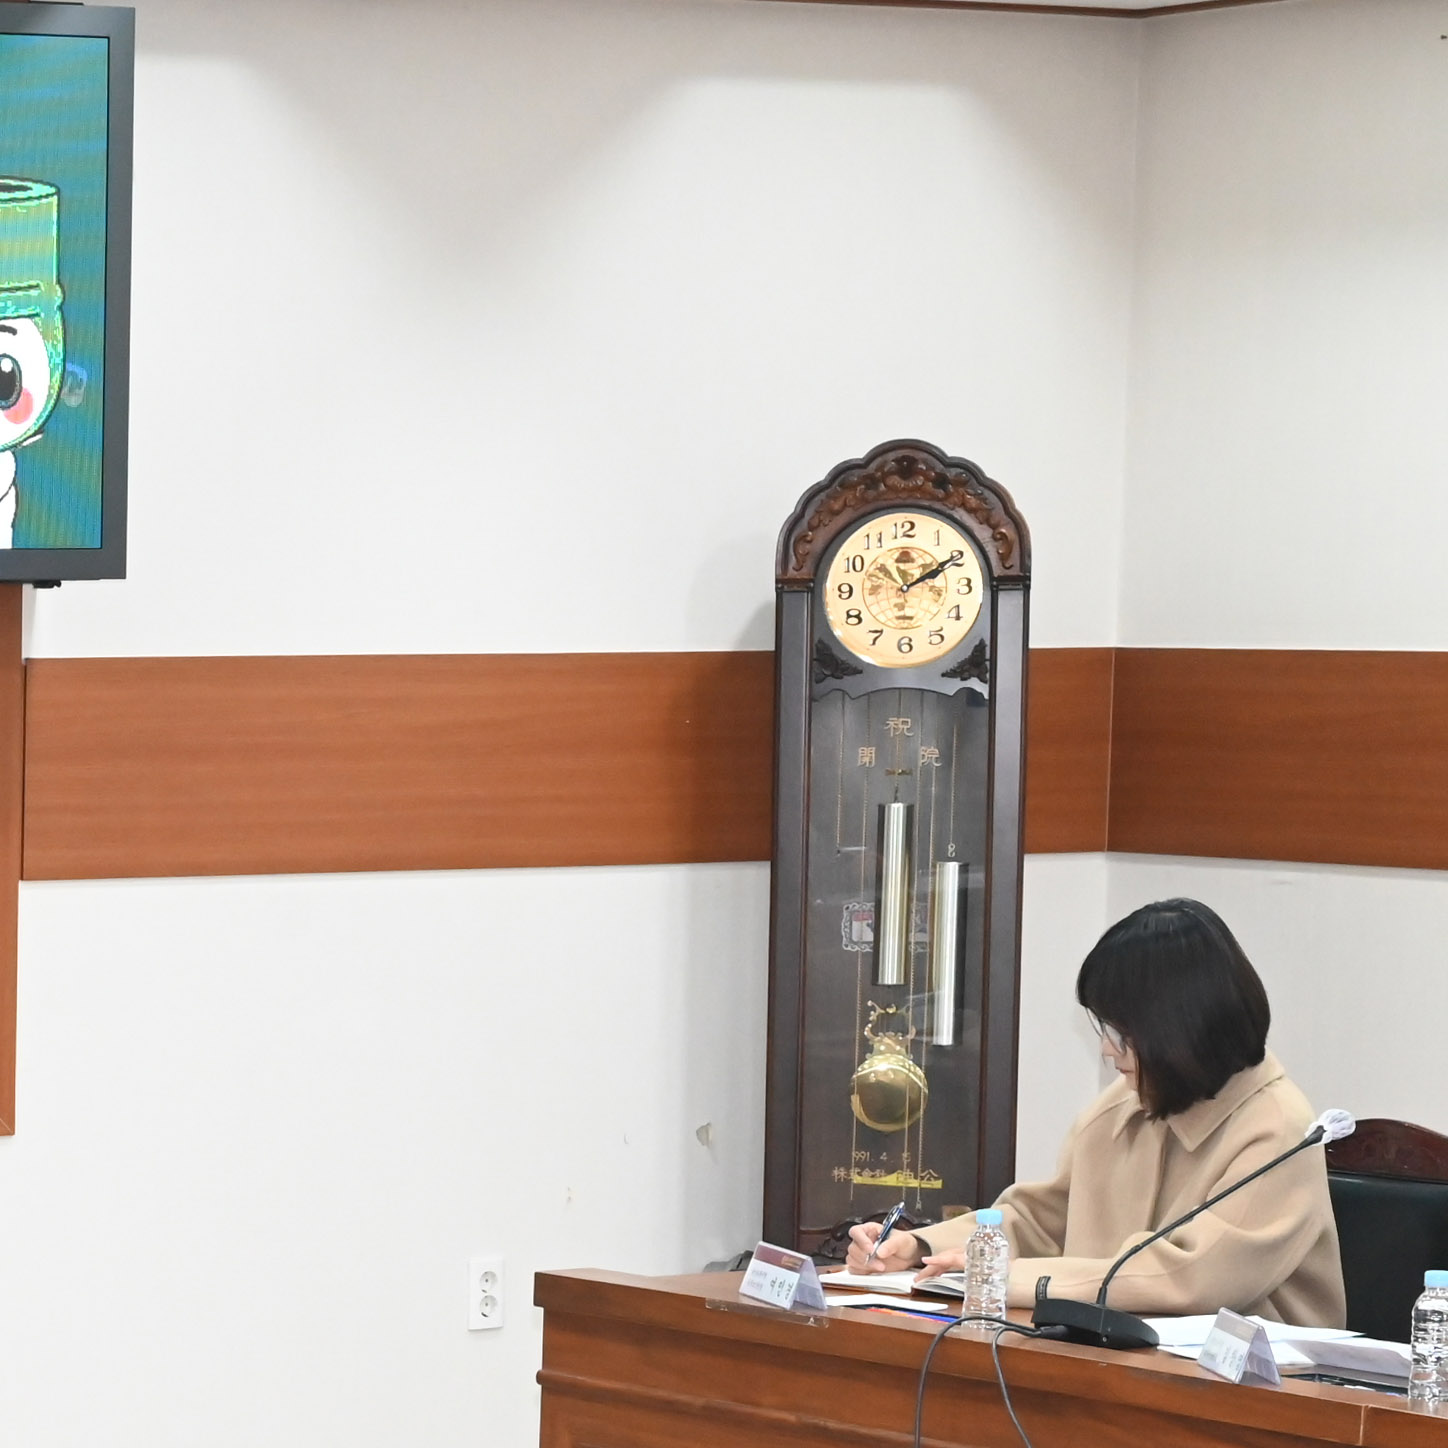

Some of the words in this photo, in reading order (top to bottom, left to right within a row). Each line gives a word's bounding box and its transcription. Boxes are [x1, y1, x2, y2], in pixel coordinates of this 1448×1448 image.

[891, 520, 916, 539] 12
[933, 529, 940, 546] 1
[864, 532, 883, 550] 11
[844, 554, 865, 573] 10
[949, 550, 965, 567] 2
[837, 582, 854, 600] 9
[956, 577, 973, 595] 3
[845, 608, 863, 626] 8
[947, 604, 963, 621] 4
[867, 628, 884, 646] 7
[928, 626, 945, 645] 5
[897, 636, 913, 654] 6
[884, 717, 914, 737] 祝
